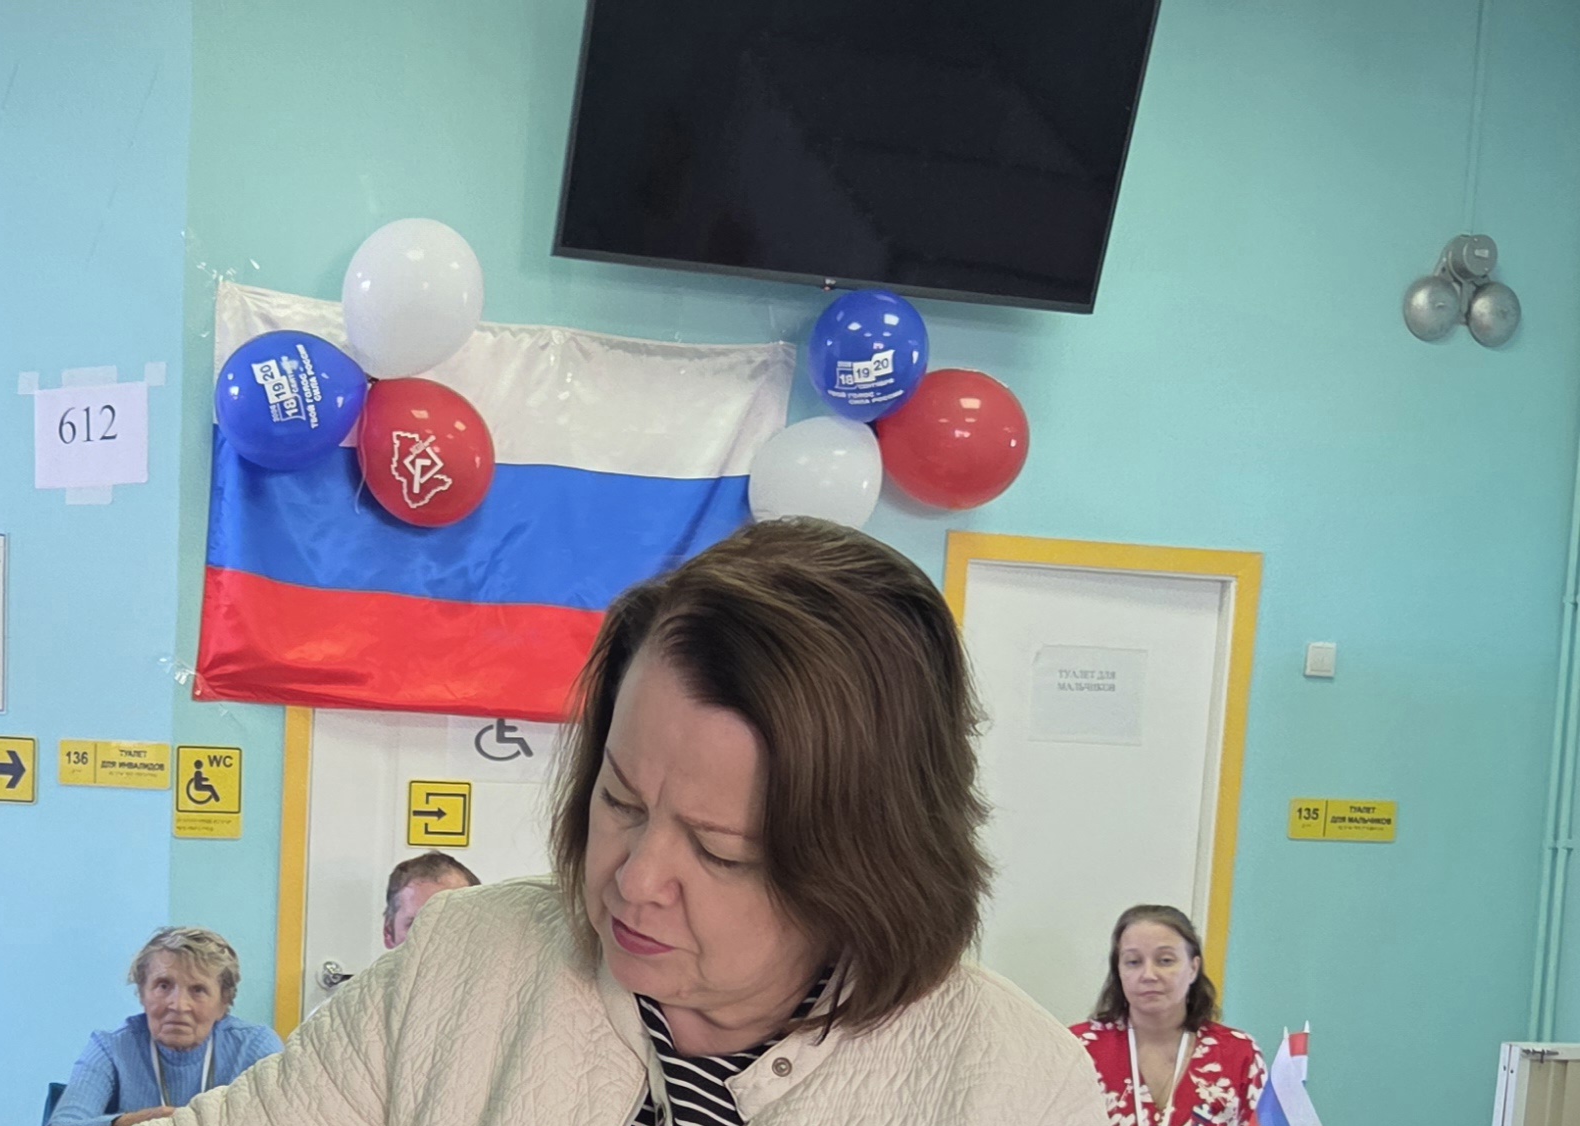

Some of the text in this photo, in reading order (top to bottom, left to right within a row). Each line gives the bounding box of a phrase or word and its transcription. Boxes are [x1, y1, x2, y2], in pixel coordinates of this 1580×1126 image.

[856, 367, 870, 379] 19
[873, 358, 889, 371] 20
[259, 364, 299, 417] 18 19 20
[58, 404, 118, 445] 612
[66, 751, 89, 765] 136
[207, 755, 234, 769] WC
[1297, 807, 1320, 821] 135
